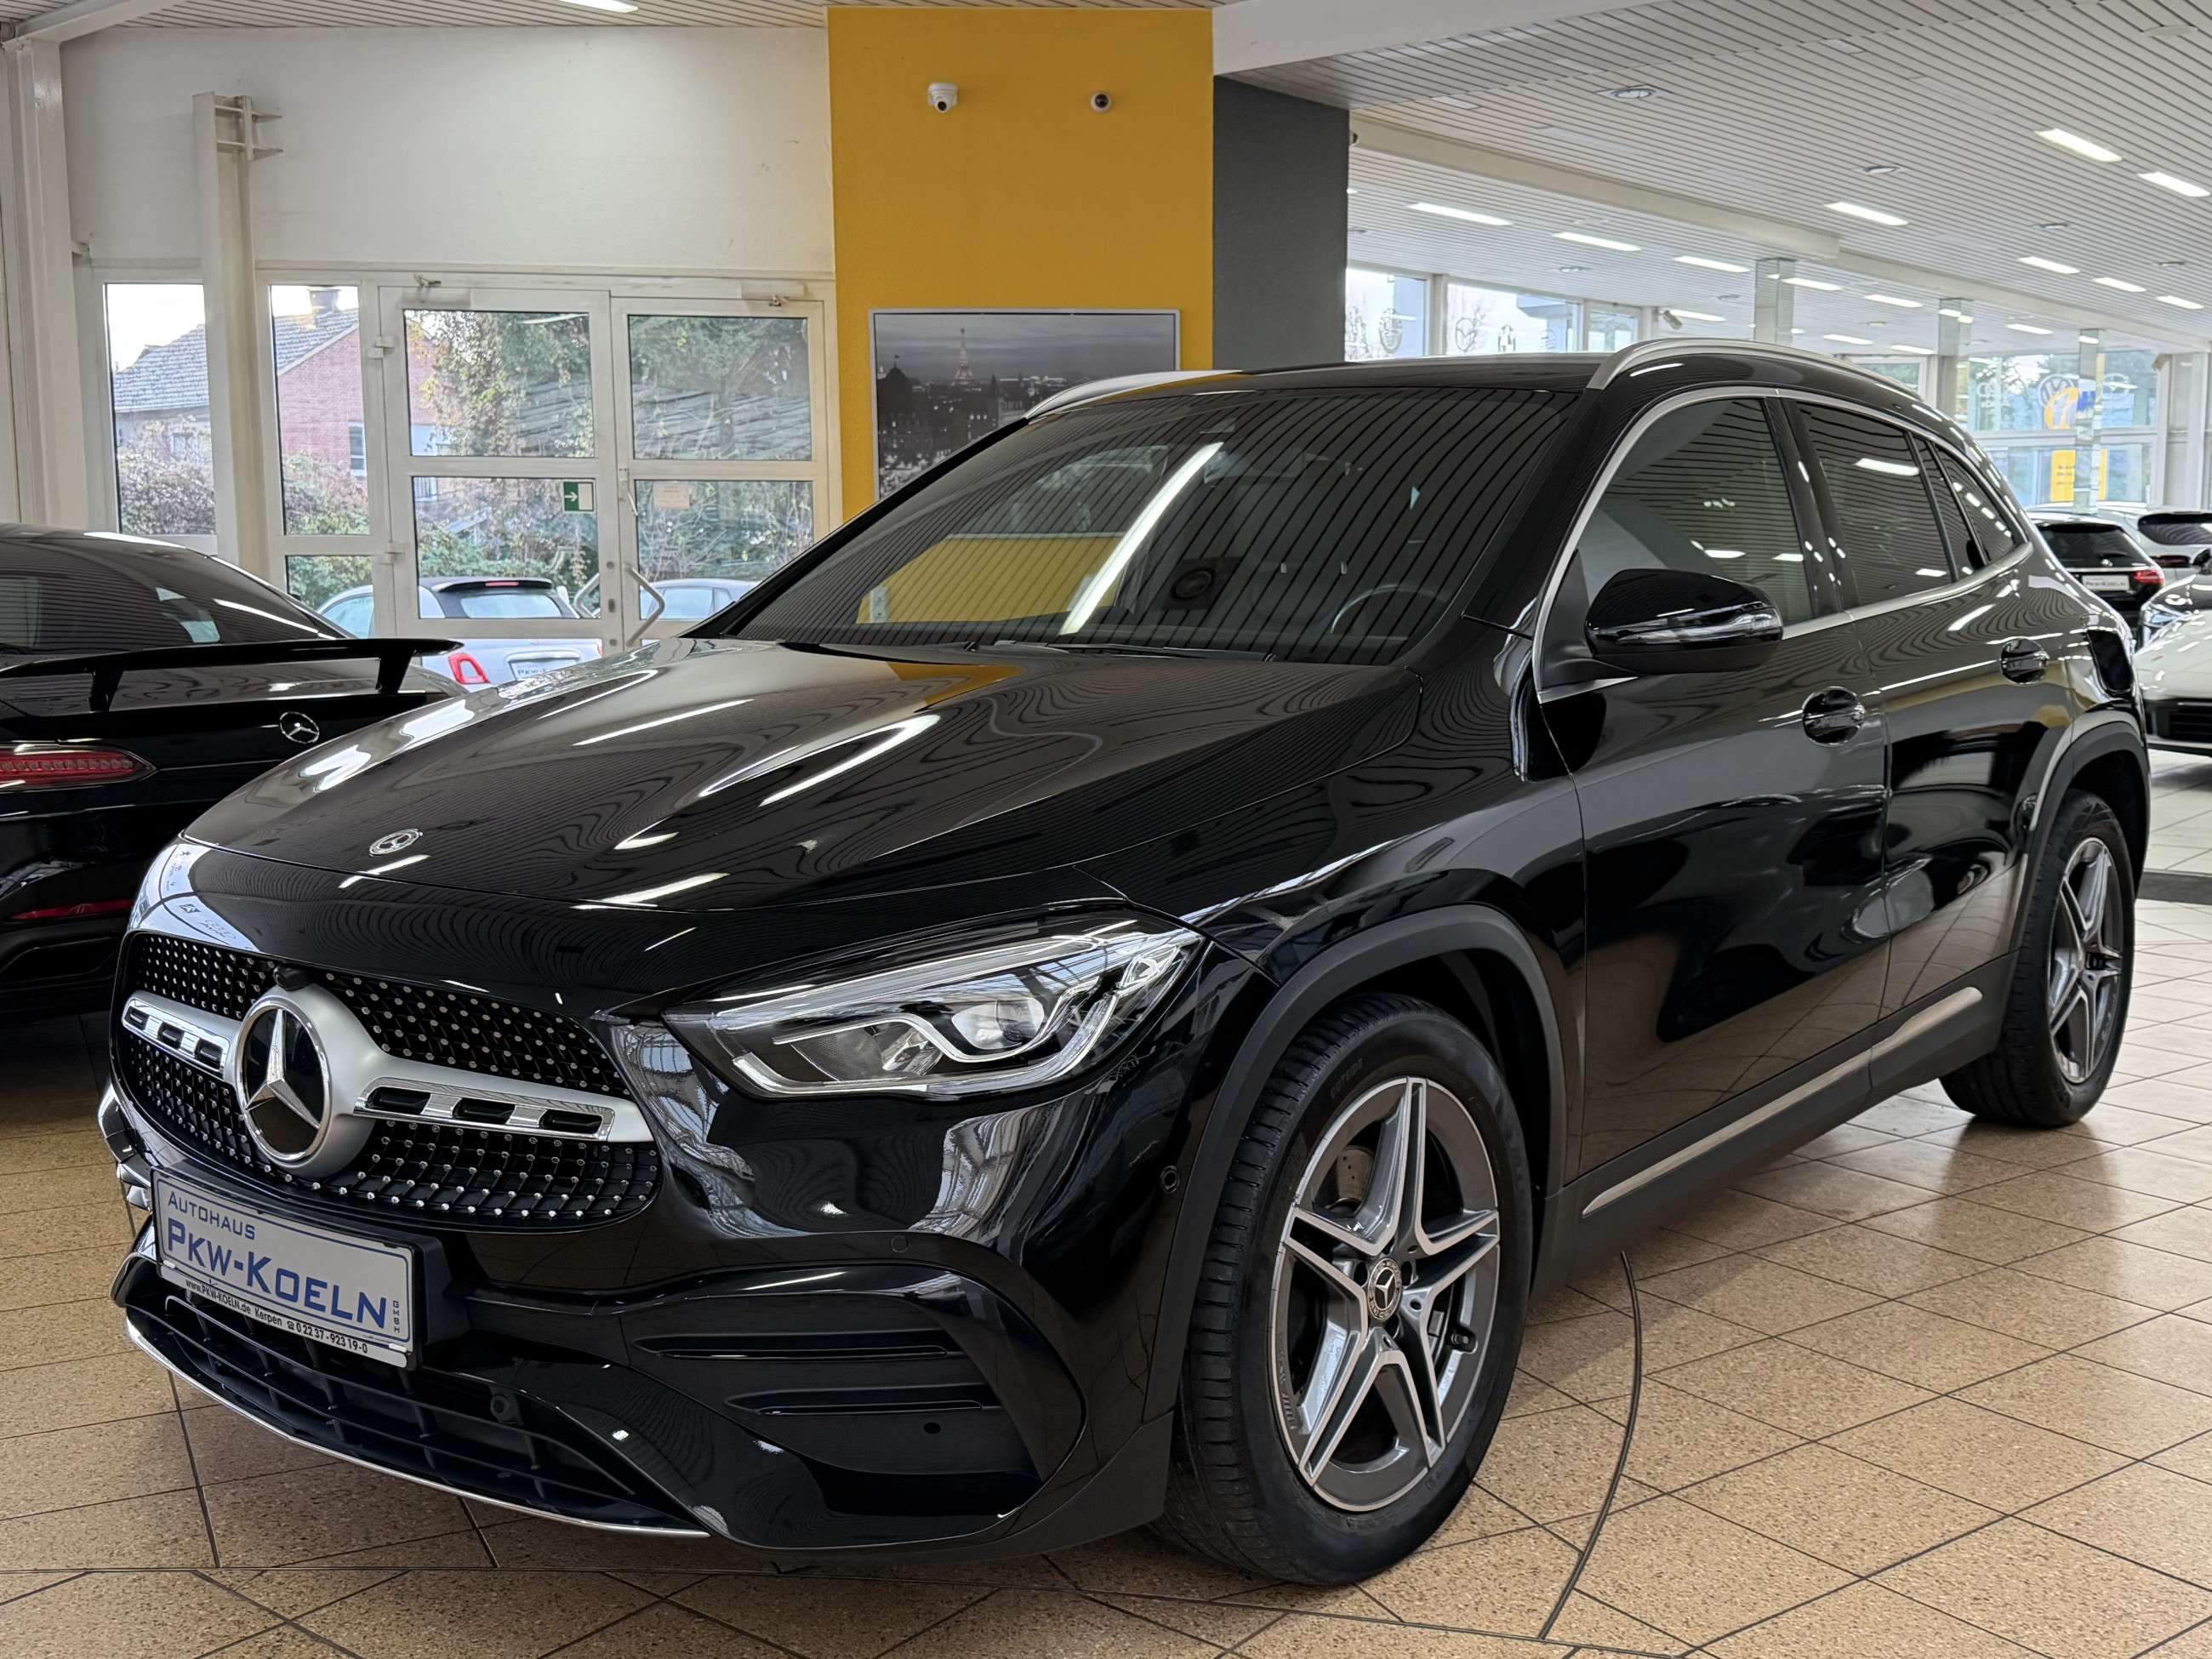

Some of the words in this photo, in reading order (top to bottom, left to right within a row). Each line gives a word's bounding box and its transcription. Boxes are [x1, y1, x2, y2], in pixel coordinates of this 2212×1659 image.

[168, 1192, 256, 1240] AUTOHAUS
[168, 1218, 387, 1328] PKW-KOELN
[185, 1279, 252, 1314] www.PKW-KOELN.de
[255, 1308, 282, 1327] Kerpen
